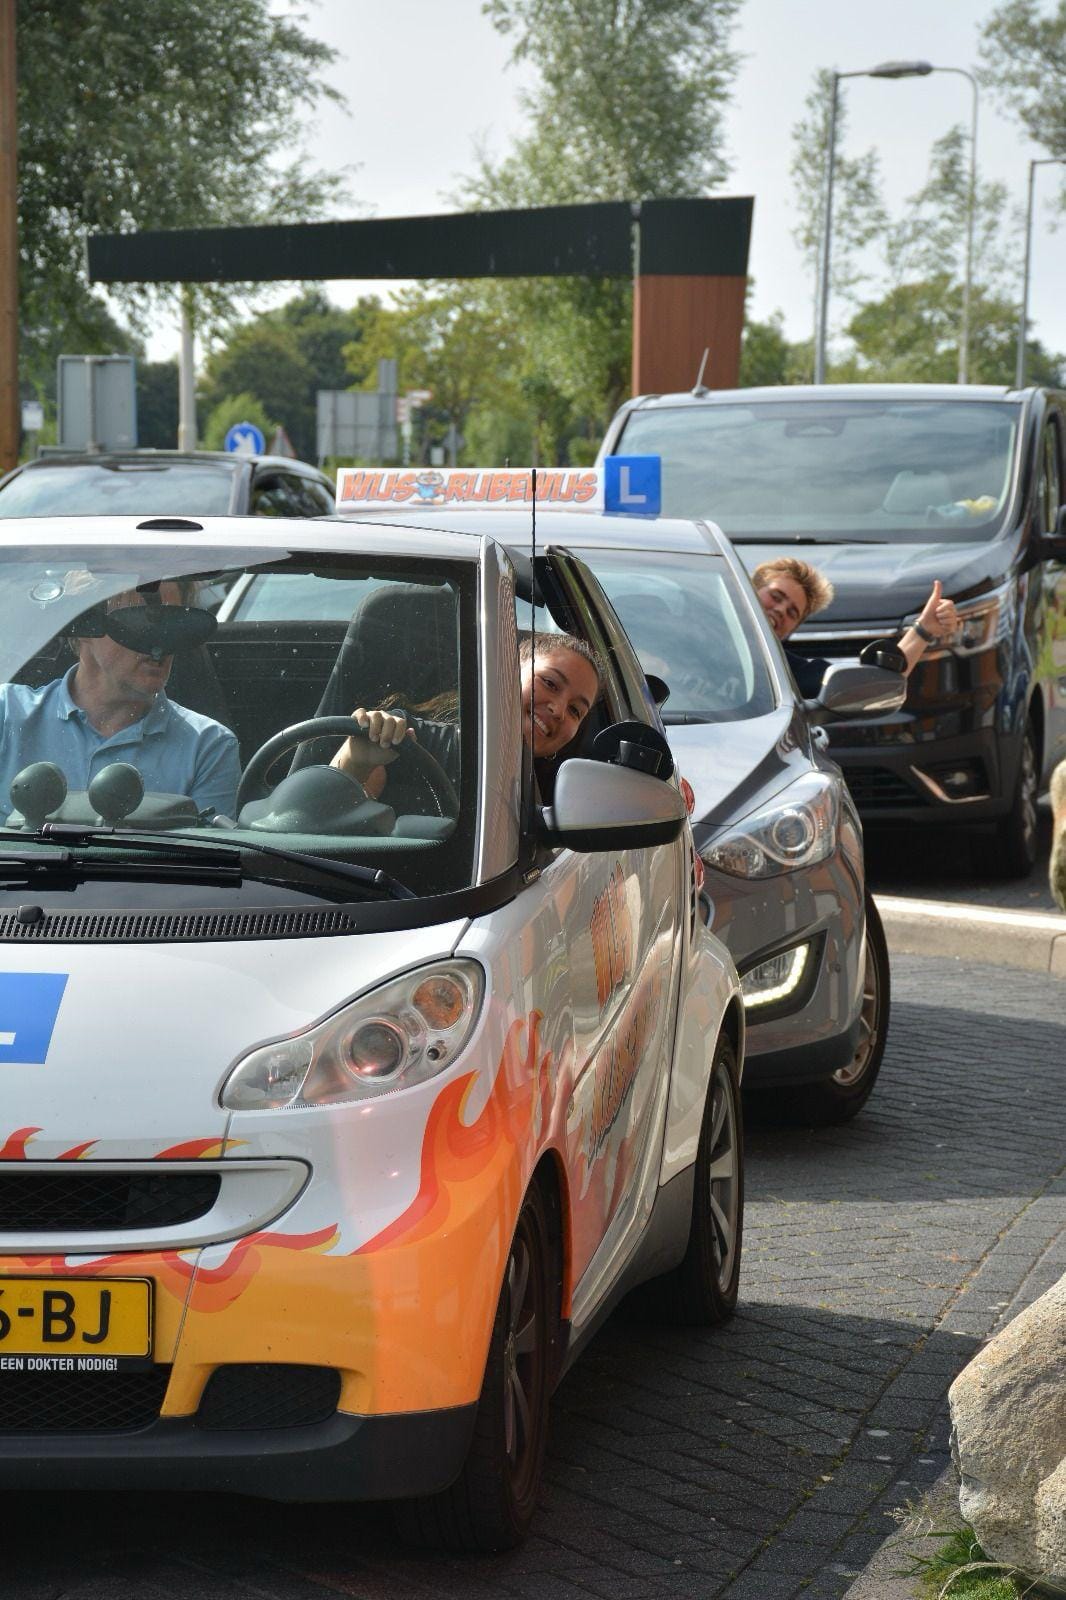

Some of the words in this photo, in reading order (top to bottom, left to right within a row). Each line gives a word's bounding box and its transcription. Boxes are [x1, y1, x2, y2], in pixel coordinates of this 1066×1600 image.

[341, 471, 417, 502] WIJS
[445, 471, 598, 503] RIJBEWIJS
[619, 466, 647, 504] L
[0, 1357, 24, 1370] EEN
[27, 1358, 74, 1371] DOKTER
[77, 1358, 118, 1371] NODIG!
